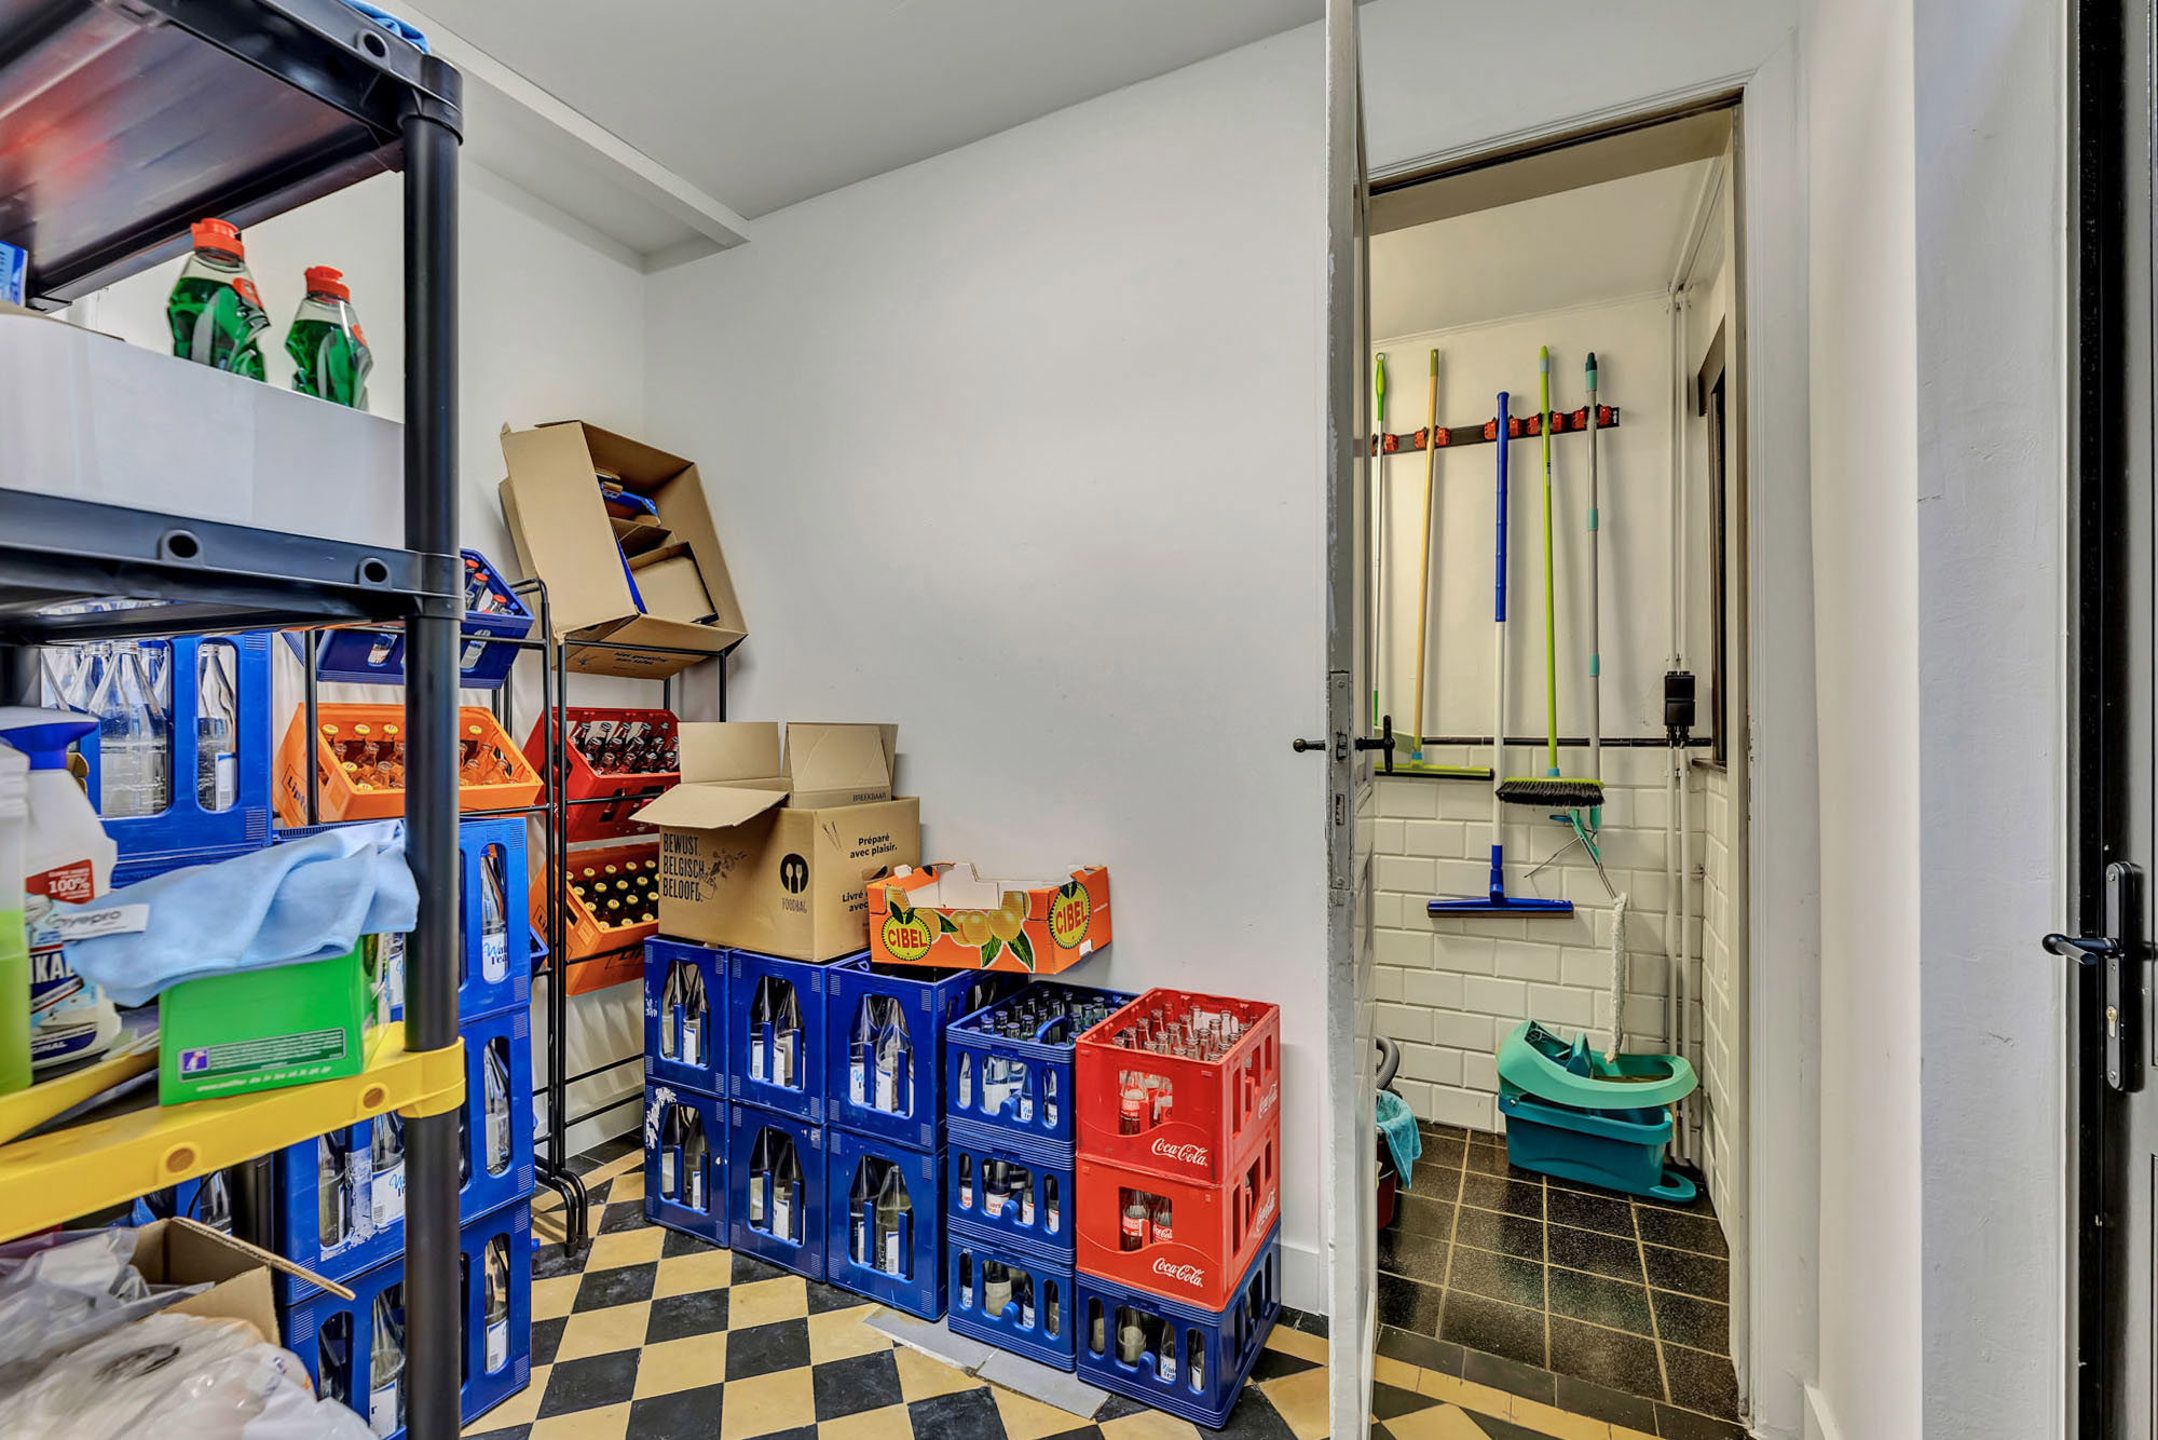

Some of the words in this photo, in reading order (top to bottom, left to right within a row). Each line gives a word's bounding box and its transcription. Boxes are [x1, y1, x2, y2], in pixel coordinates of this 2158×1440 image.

[858, 833, 890, 846] Préparé
[849, 849, 870, 859] avec
[871, 843, 898, 857] plaisir.
[48, 879, 90, 894] 100%
[842, 890, 864, 902] Livré
[1056, 900, 1087, 935] CIBEL
[888, 928, 928, 949] CIBEL
[1151, 1138, 1208, 1167] Coca-Cola
[1153, 1257, 1204, 1288] Coca-Cola
